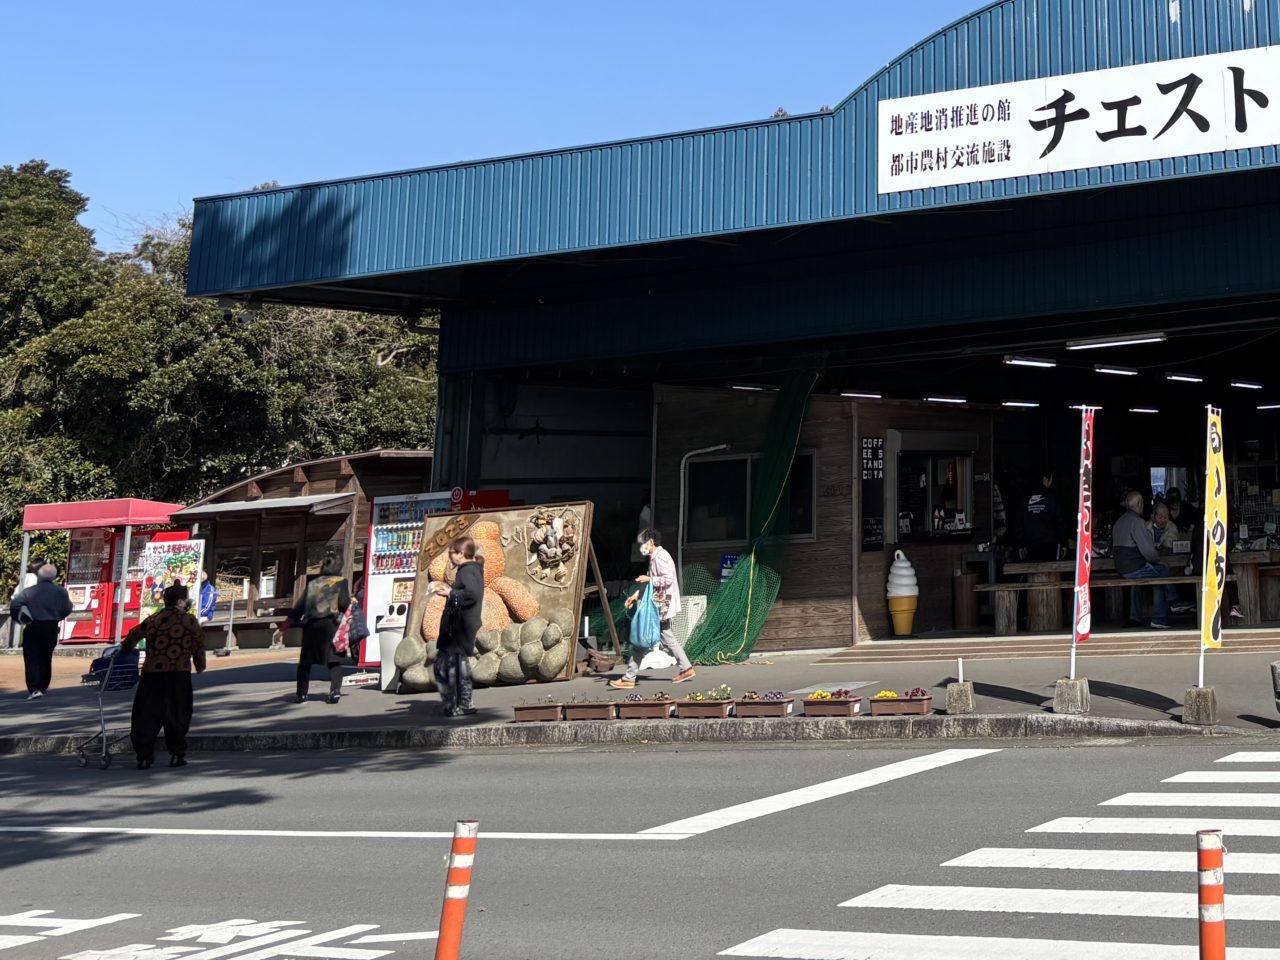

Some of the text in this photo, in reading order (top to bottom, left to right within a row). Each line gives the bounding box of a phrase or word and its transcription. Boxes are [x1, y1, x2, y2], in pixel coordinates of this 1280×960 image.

[890, 98, 1011, 136] 地産地消推進の館
[890, 139, 1011, 177] 都市農村交流施設
[862, 438, 883, 448] COFF
[862, 449, 873, 459] EE
[862, 459, 883, 469] TAND
[424, 514, 470, 557] 2023
